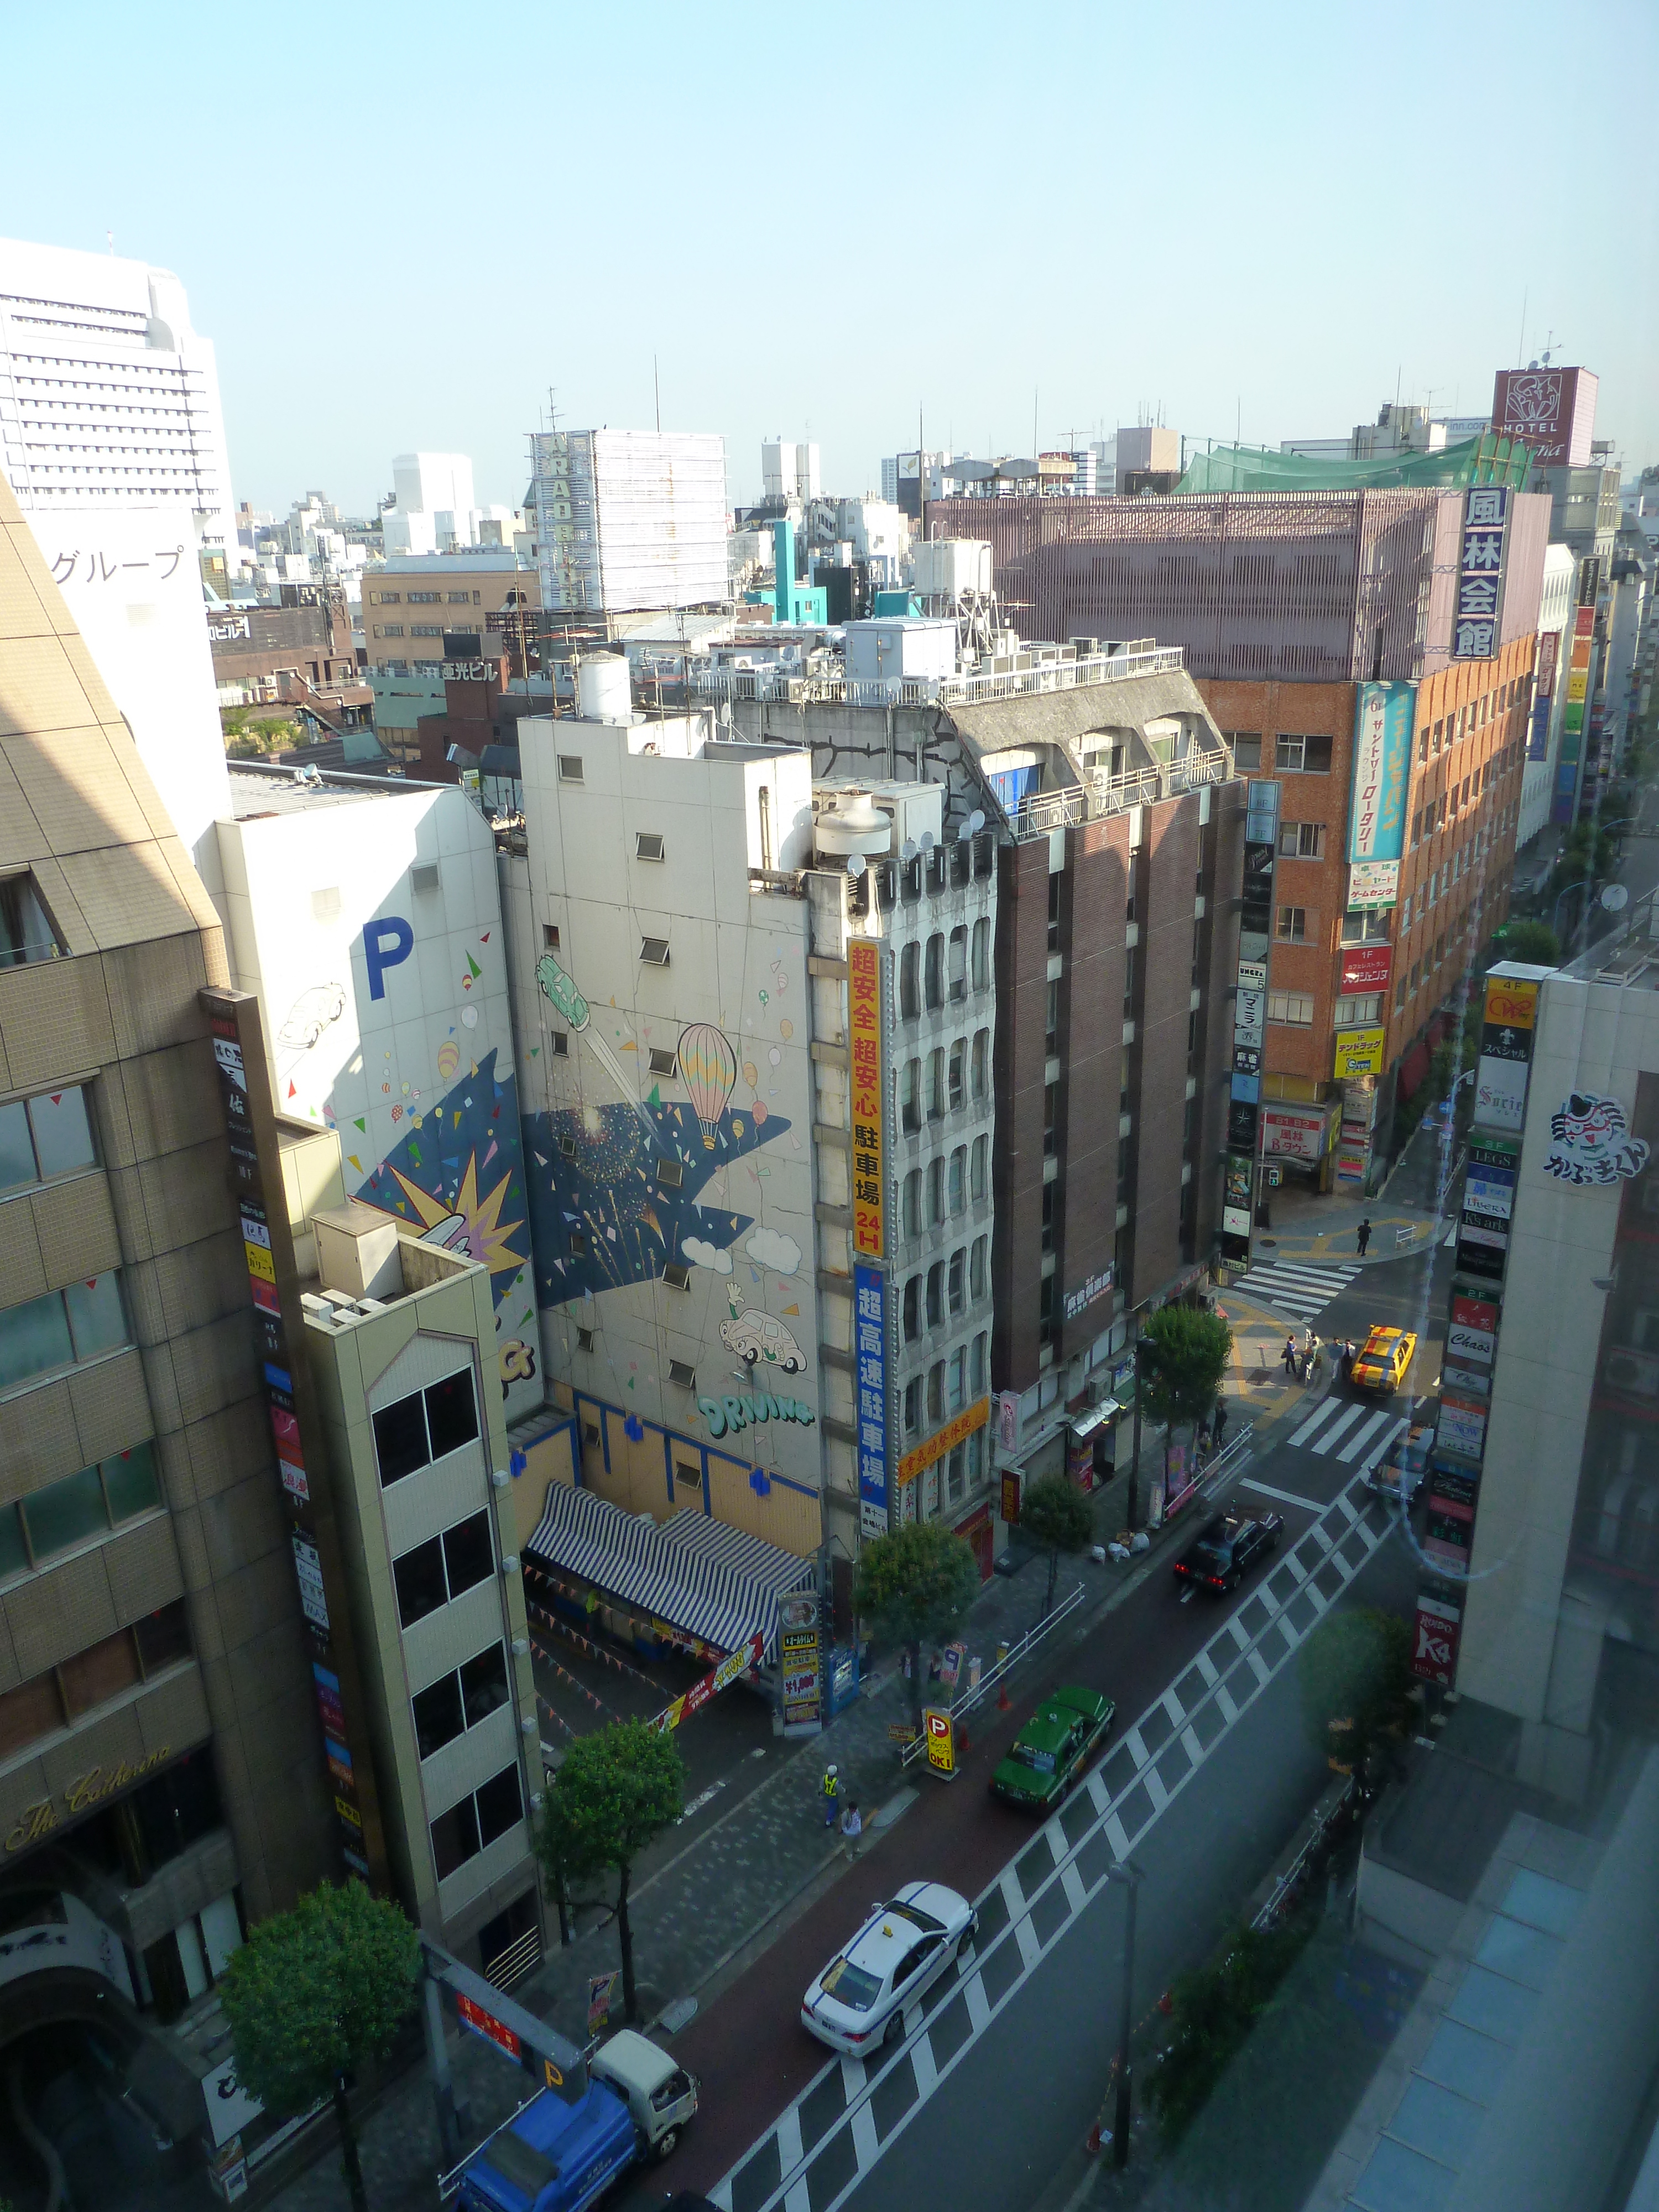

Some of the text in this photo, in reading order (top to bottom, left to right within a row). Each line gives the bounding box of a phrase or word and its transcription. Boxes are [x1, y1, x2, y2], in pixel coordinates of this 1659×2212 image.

[1504, 423, 1557, 433] HOTEL
[50, 545, 185, 587] グループ
[1456, 490, 1505, 656] 風林会館
[442, 662, 498, 681] 亜光ビル
[1350, 888, 1396, 898] ゲームセンター
[363, 916, 414, 1001] P
[1362, 951, 1374, 959] 1F
[852, 947, 877, 1032] 超安全
[1503, 982, 1522, 990] 4F
[1338, 1040, 1381, 1052] テンドラッグ
[854, 1036, 878, 1119] 超安心
[1280, 1129, 1304, 1142] 風林
[854, 1124, 880, 1206] 駐車場
[1468, 1288, 1485, 1299] 2F
[1451, 1333, 1490, 1353] Chaos
[858, 1287, 885, 1488] 超高速駐車場
[698, 1394, 815, 1439] DRIVING
[1416, 1625, 1451, 1665] K4
[932, 1718, 946, 1735] P
